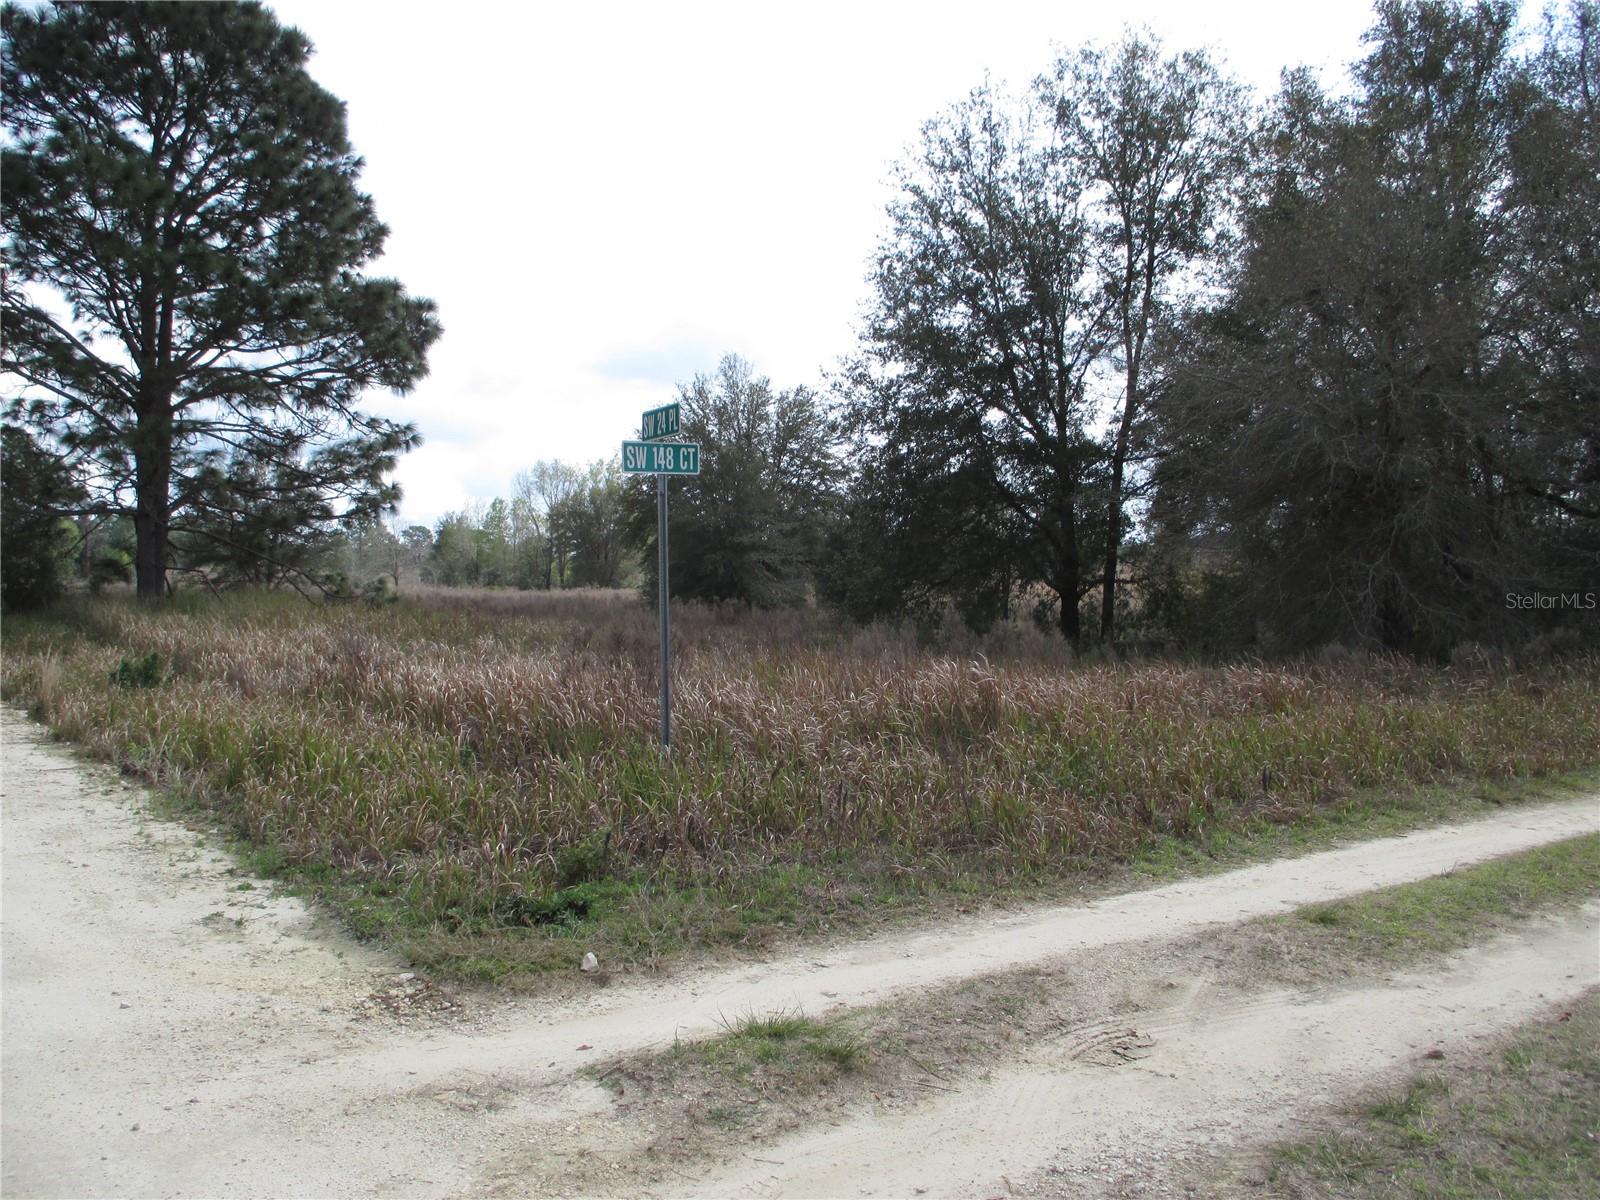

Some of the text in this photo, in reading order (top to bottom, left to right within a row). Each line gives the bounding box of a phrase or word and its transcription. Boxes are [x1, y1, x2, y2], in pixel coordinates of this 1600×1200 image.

[643, 413, 655, 438] SW
[669, 407, 678, 431] PL
[626, 446, 696, 470] SW 148 CT
